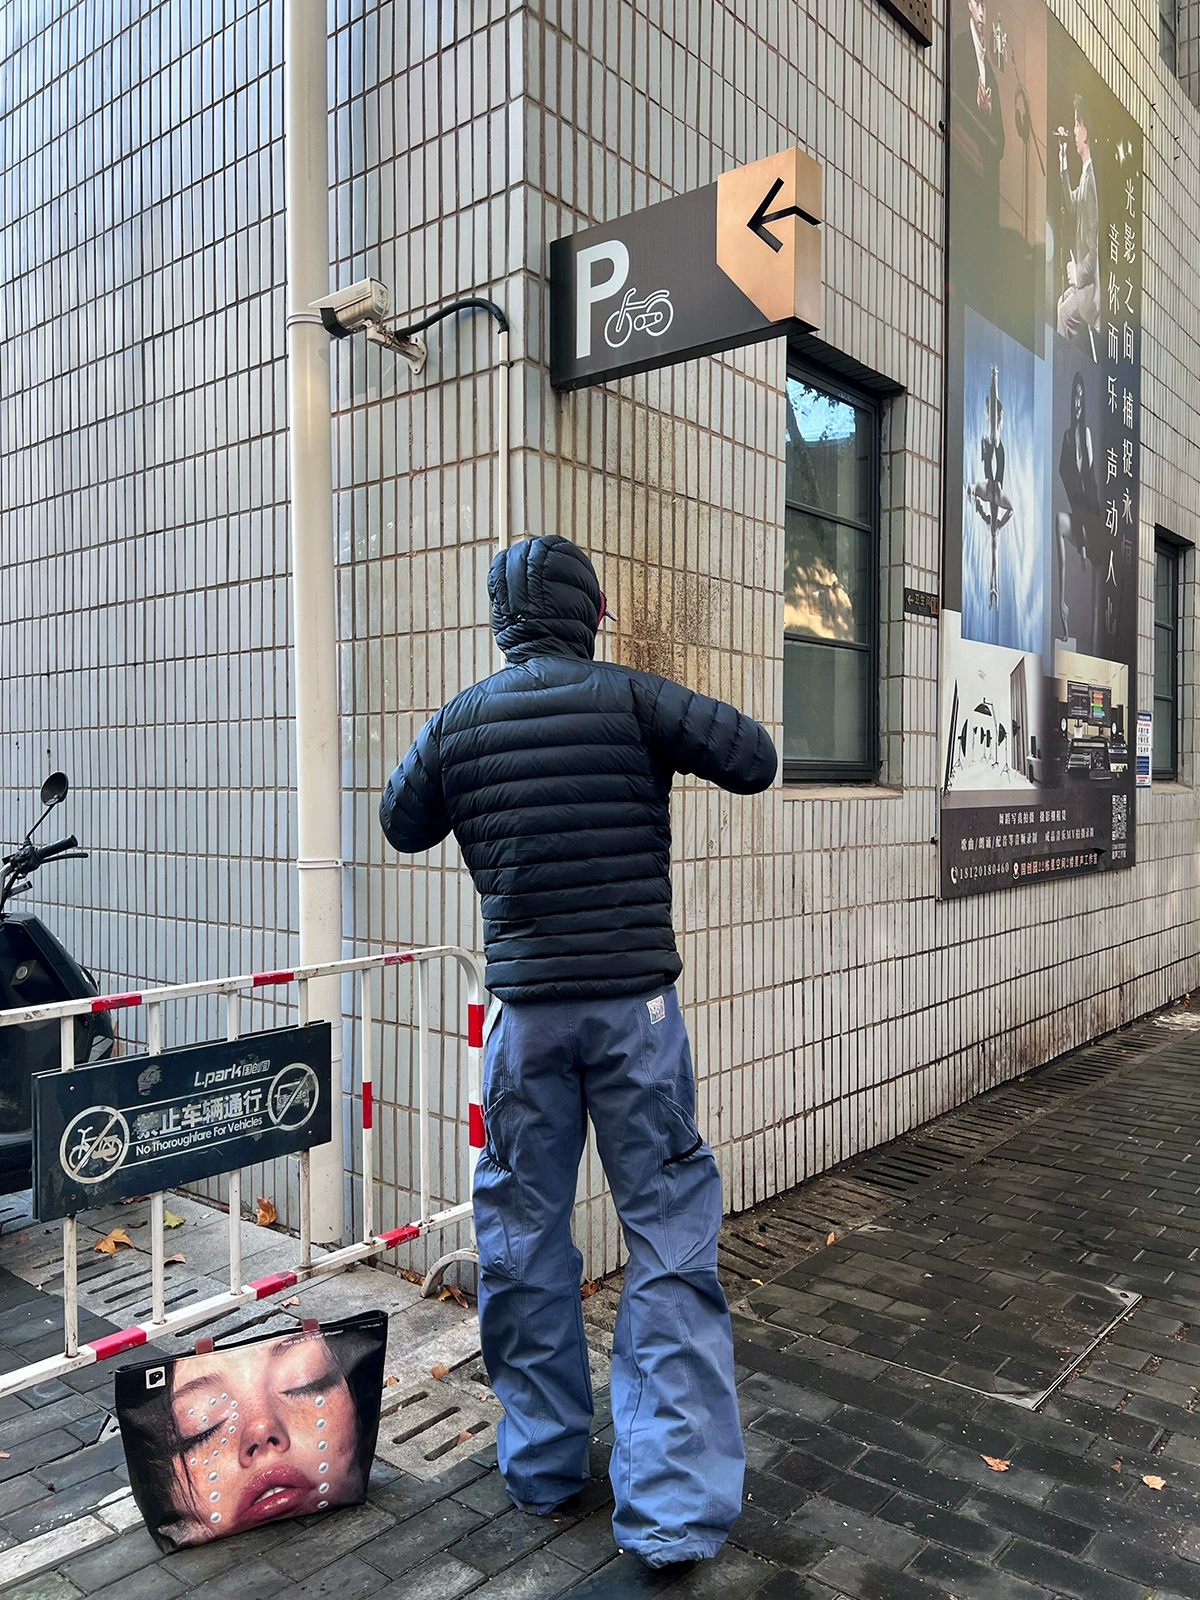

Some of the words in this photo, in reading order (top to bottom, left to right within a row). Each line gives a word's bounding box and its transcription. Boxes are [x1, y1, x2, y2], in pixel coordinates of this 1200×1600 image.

[576, 239, 630, 360] P
[136, 1088, 263, 1140] 禁止车辆通行
[136, 1144, 151, 1156] No
[152, 1130, 212, 1152] Thoroughfare
[213, 1126, 227, 1137] For
[227, 1117, 263, 1133] Vehicles
